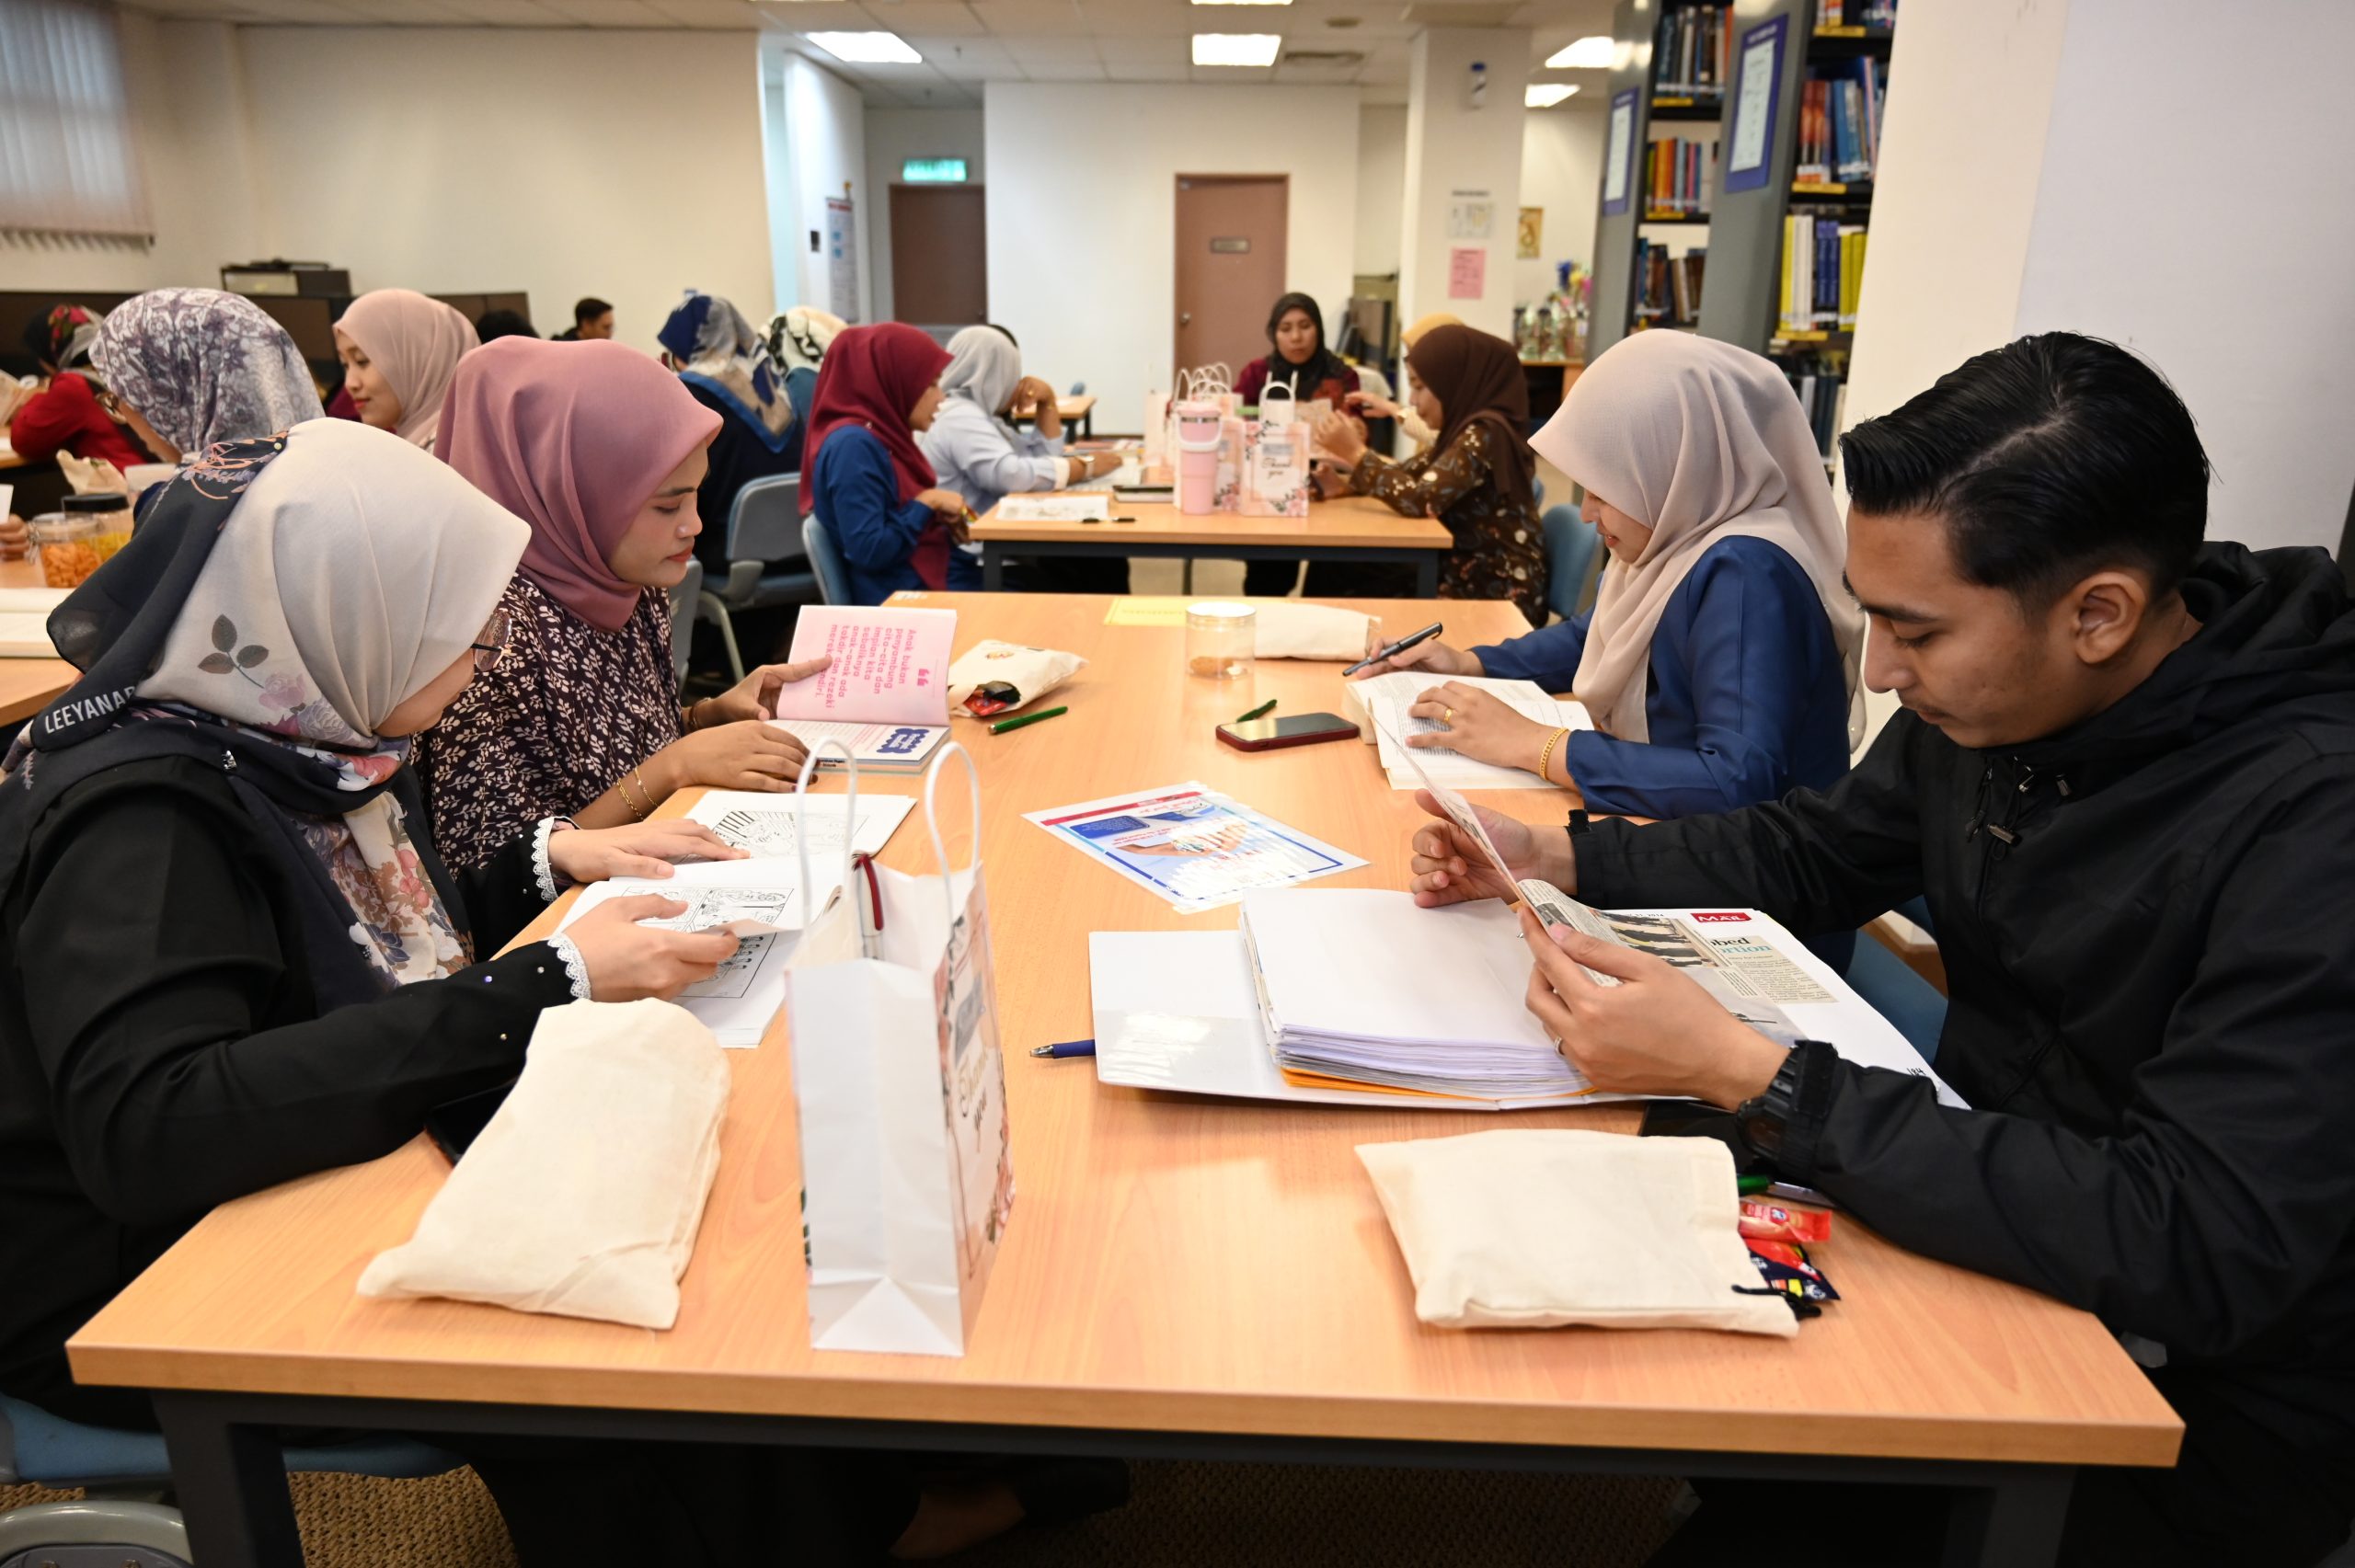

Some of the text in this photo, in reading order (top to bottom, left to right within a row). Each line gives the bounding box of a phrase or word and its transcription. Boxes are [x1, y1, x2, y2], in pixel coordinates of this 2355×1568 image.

[825, 625, 850, 708] takdir dan rezeki
[838, 625, 859, 697] anak-anak ada
[853, 627, 870, 677] sebaliknya
[865, 627, 883, 681] impian kita
[874, 628, 893, 694] cita-cita dan
[884, 628, 903, 689] penyambung
[899, 629, 916, 684] Anak bukan
